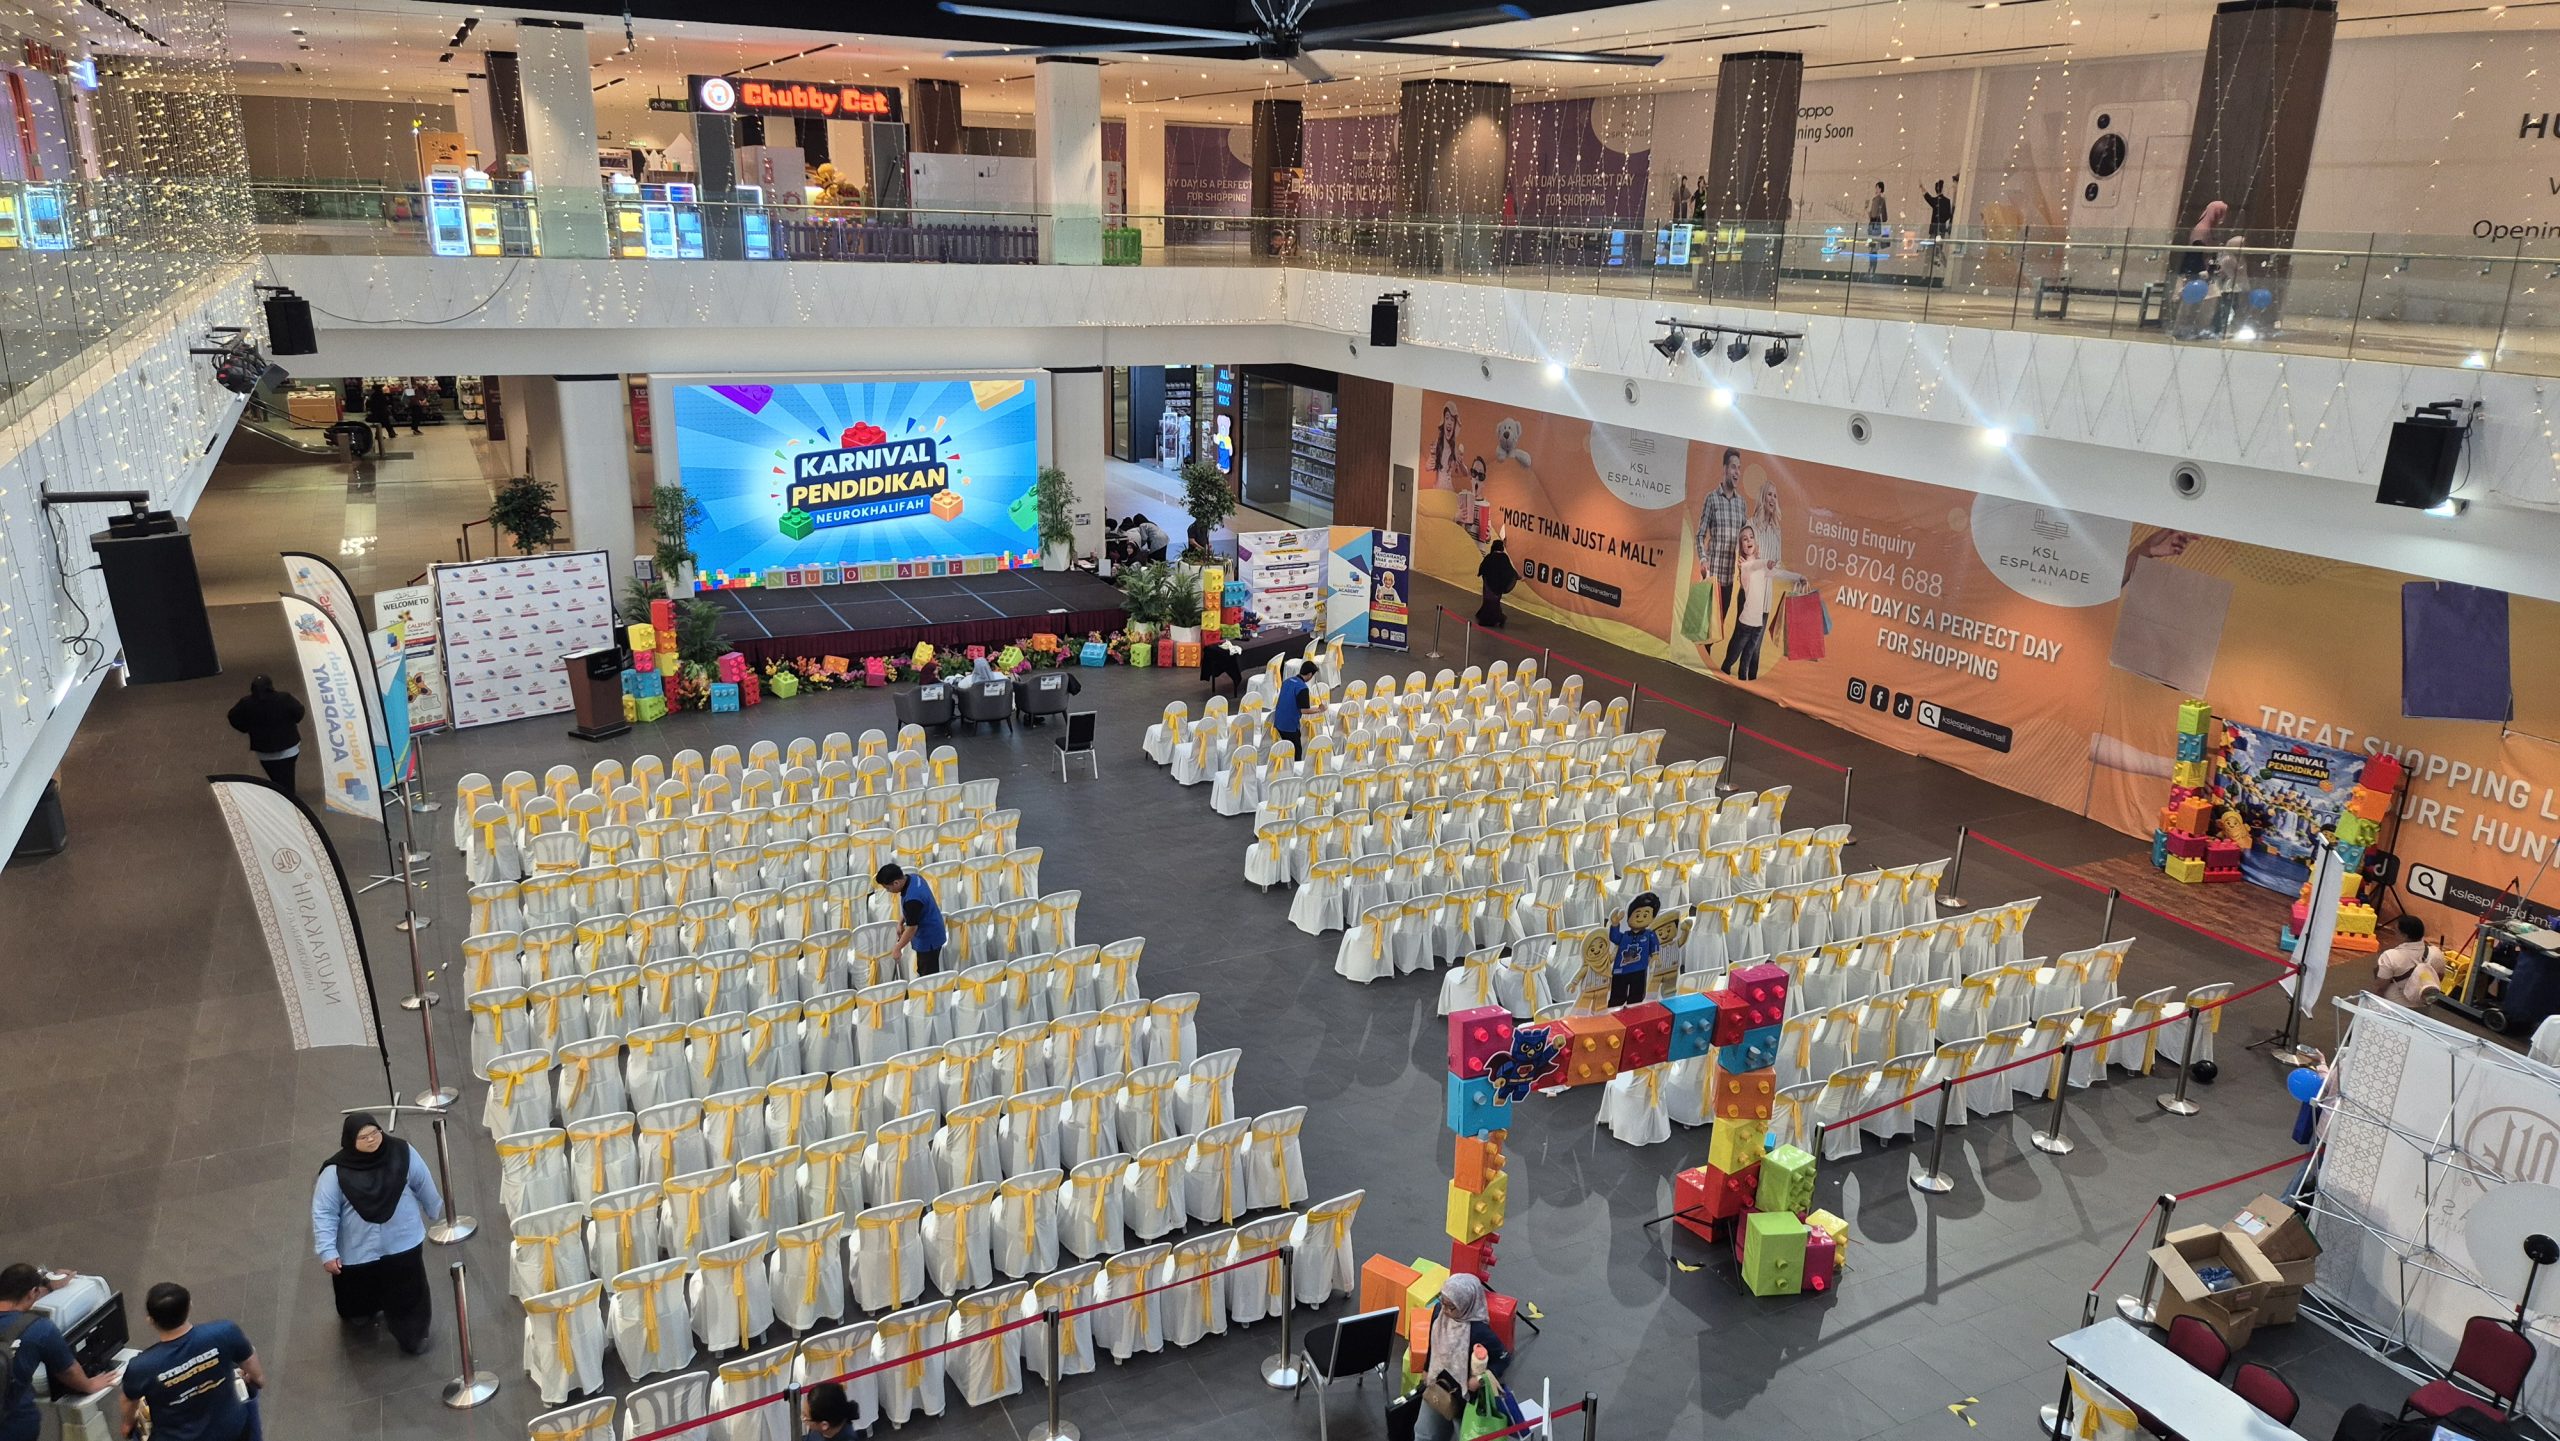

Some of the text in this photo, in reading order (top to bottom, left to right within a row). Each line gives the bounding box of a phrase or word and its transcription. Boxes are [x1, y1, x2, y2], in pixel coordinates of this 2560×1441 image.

[742, 83, 889, 115] Chubby Cat
[1798, 105, 1834, 119] oppo
[1824, 123, 1854, 138] Soon
[2519, 113, 2560, 139] H
[1167, 179, 1179, 188] NY
[1181, 179, 1197, 188] DAY
[1199, 179, 1207, 188] IS
[1217, 180, 1252, 189] PERFECT
[1541, 175, 1557, 187] DAY
[1616, 174, 1635, 186] DAY
[1187, 192, 1247, 202] FOR SHOPPING
[1337, 184, 1354, 201] THE
[1356, 184, 1377, 201] NEW
[1545, 193, 1605, 206] FOR SHOPPING
[1220, 369, 1229, 380] ALL
[1216, 381, 1232, 394] ABOUT
[1219, 394, 1230, 406] KIDS
[801, 443, 931, 478] KARNIVAL
[1630, 462, 1649, 475] KSL
[792, 467, 945, 506] PENDIDIKAN
[1608, 472, 1671, 494] ESPLANADE
[816, 498, 924, 524] NEUROKHALIFAH
[1538, 516, 1569, 542] THAN
[1572, 527, 1605, 552] JUST
[1608, 537, 1616, 556] A
[1808, 516, 1916, 559] Leasing Enquiry
[2033, 546, 2059, 561] KSL
[773, 560, 995, 585] NEUROKHALIFAH
[1806, 544, 1943, 597] 018-8704 688
[2000, 555, 2090, 584] ESPLANADE
[383, 600, 419, 611] WELCOME
[1835, 585, 2062, 662] ANY DAY IS A PERFECT DAY
[1877, 628, 1999, 680] FOR SHOPPING
[2273, 752, 2324, 768] KARNIVAL
[2268, 761, 2328, 779] PENDIDIKAN
[158, 1347, 219, 1381] STRONGER
